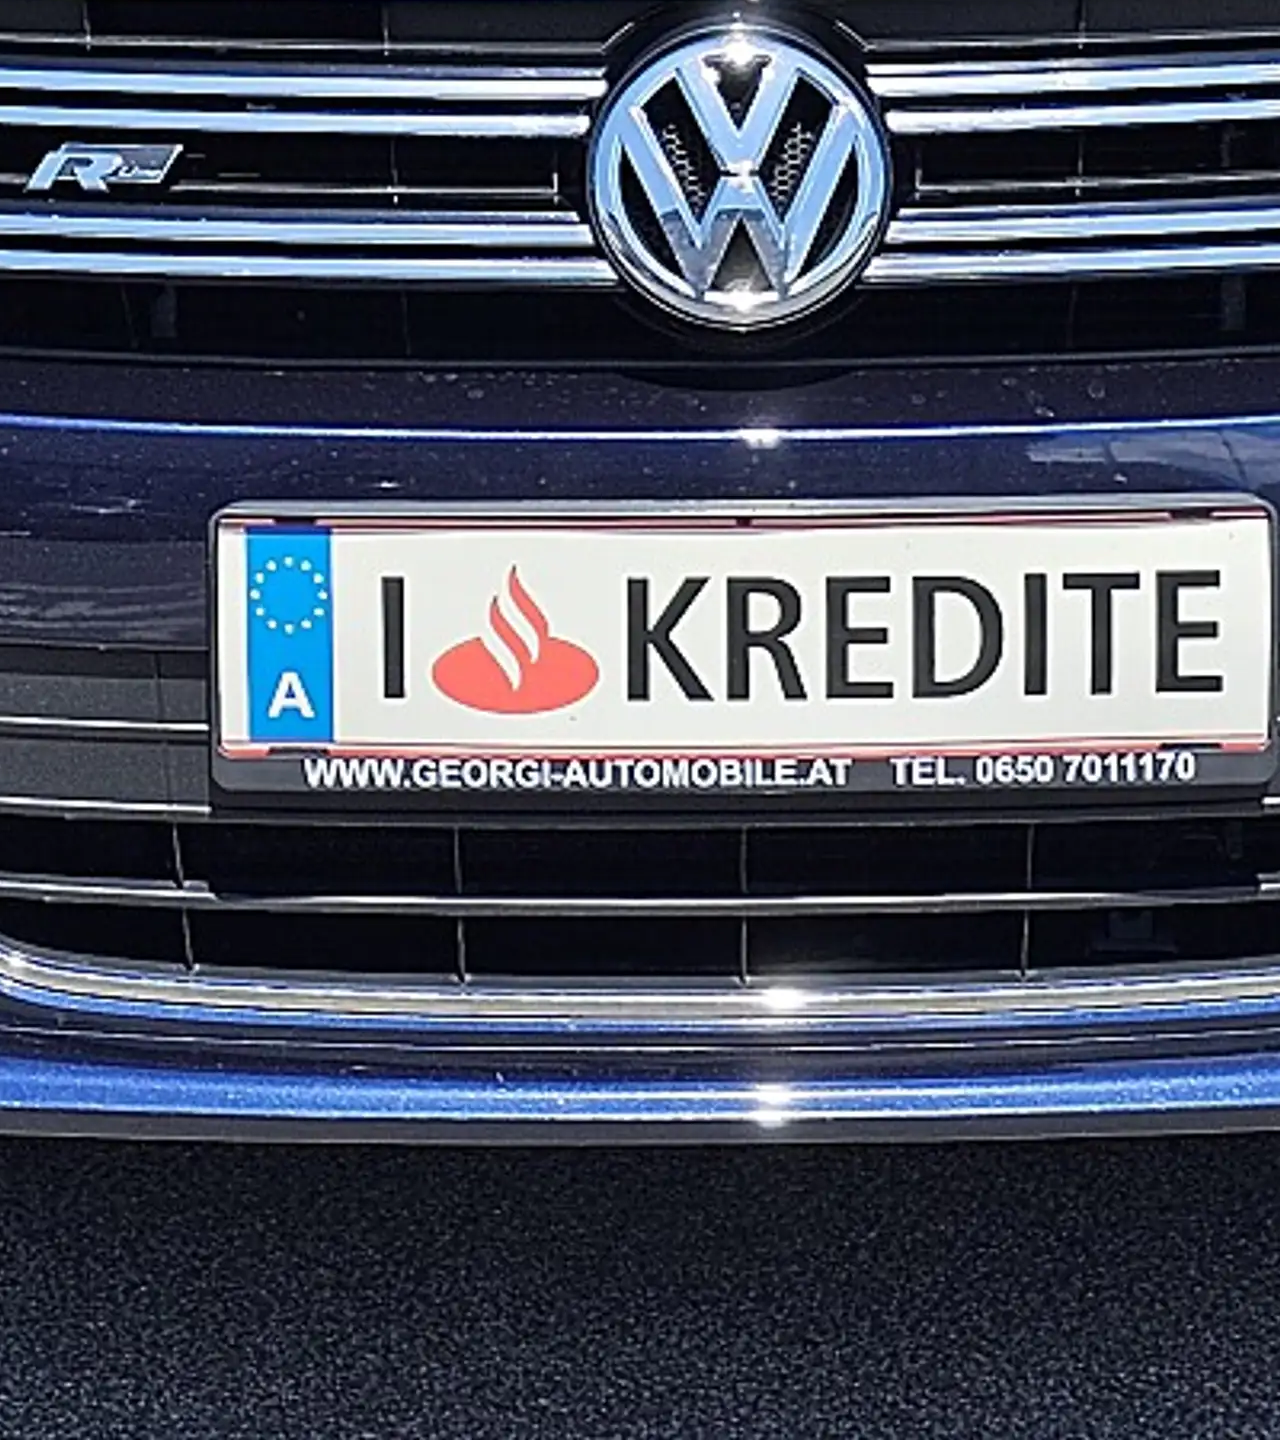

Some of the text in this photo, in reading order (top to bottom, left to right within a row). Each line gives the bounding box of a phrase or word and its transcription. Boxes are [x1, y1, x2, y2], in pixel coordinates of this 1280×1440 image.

[381, 569, 1223, 702] I KREDITE
[268, 670, 316, 719] A
[304, 750, 1197, 790] WWW.GEORGI-AUTOMOBILE.AT TEL. 0650 7011170
